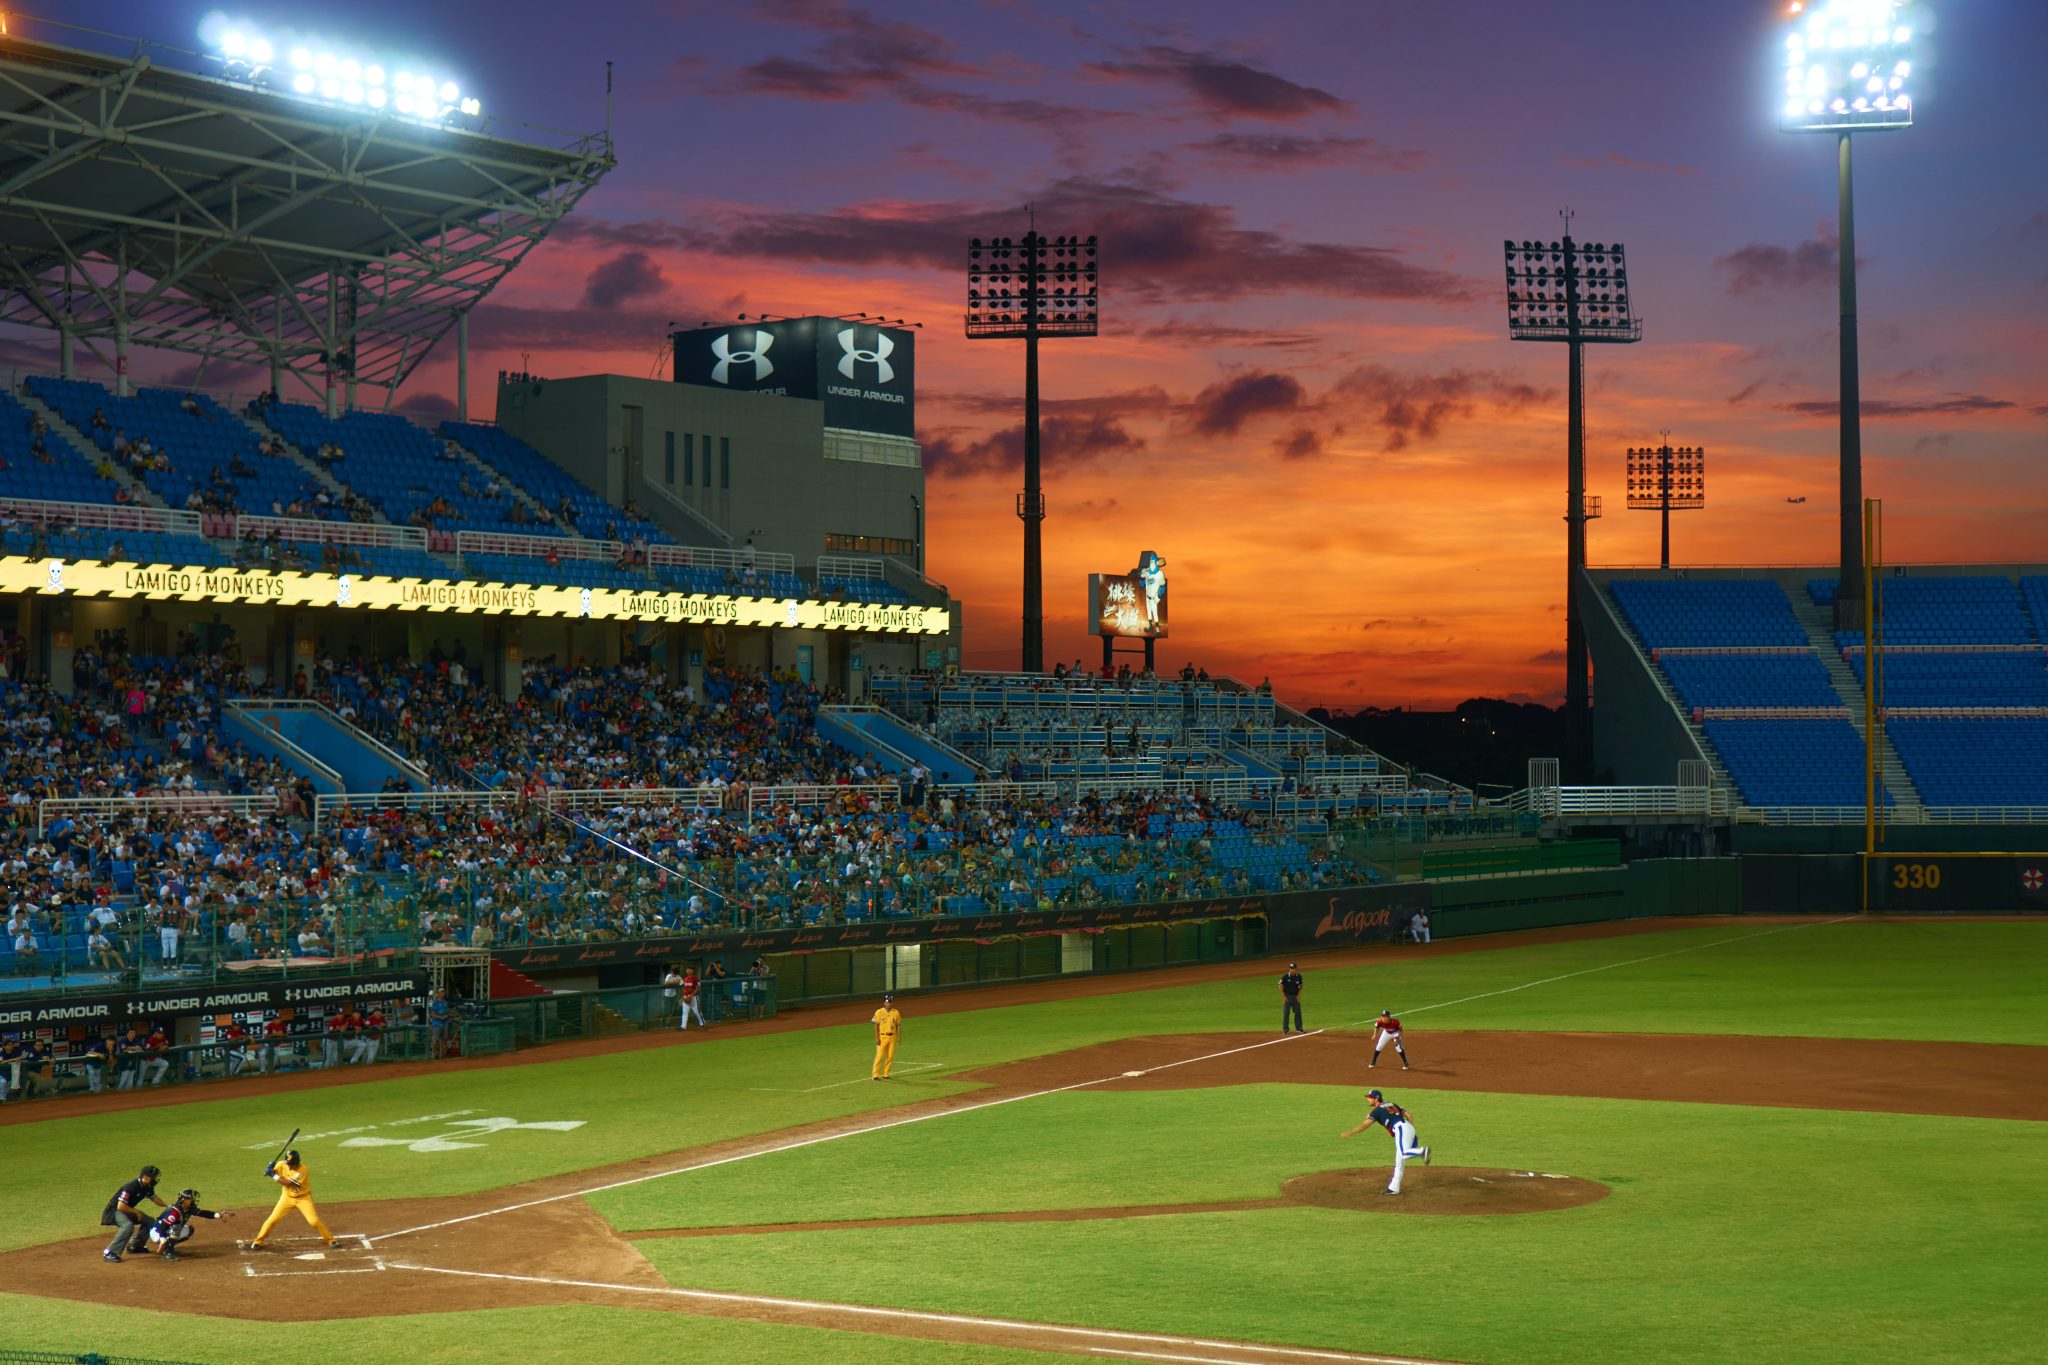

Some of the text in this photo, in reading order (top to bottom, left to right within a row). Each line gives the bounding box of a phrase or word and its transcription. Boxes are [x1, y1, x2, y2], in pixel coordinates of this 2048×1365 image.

[827, 385, 905, 404] UNDER ARMOUR
[125, 570, 284, 597] LAMIGO MONKEYS
[403, 585, 536, 608] LAMIGO MONKEYS
[622, 597, 737, 618] LAMIGO MONKEYS
[823, 607, 923, 627] LAMIGO MONKEYS
[1893, 864, 1941, 889] 330
[1314, 896, 1391, 938] Lagoon
[304, 980, 413, 999] UNDER ARMOUR
[147, 992, 268, 1012] UNDER ARMOUR
[36, 1005, 108, 1021] ARMOUR
